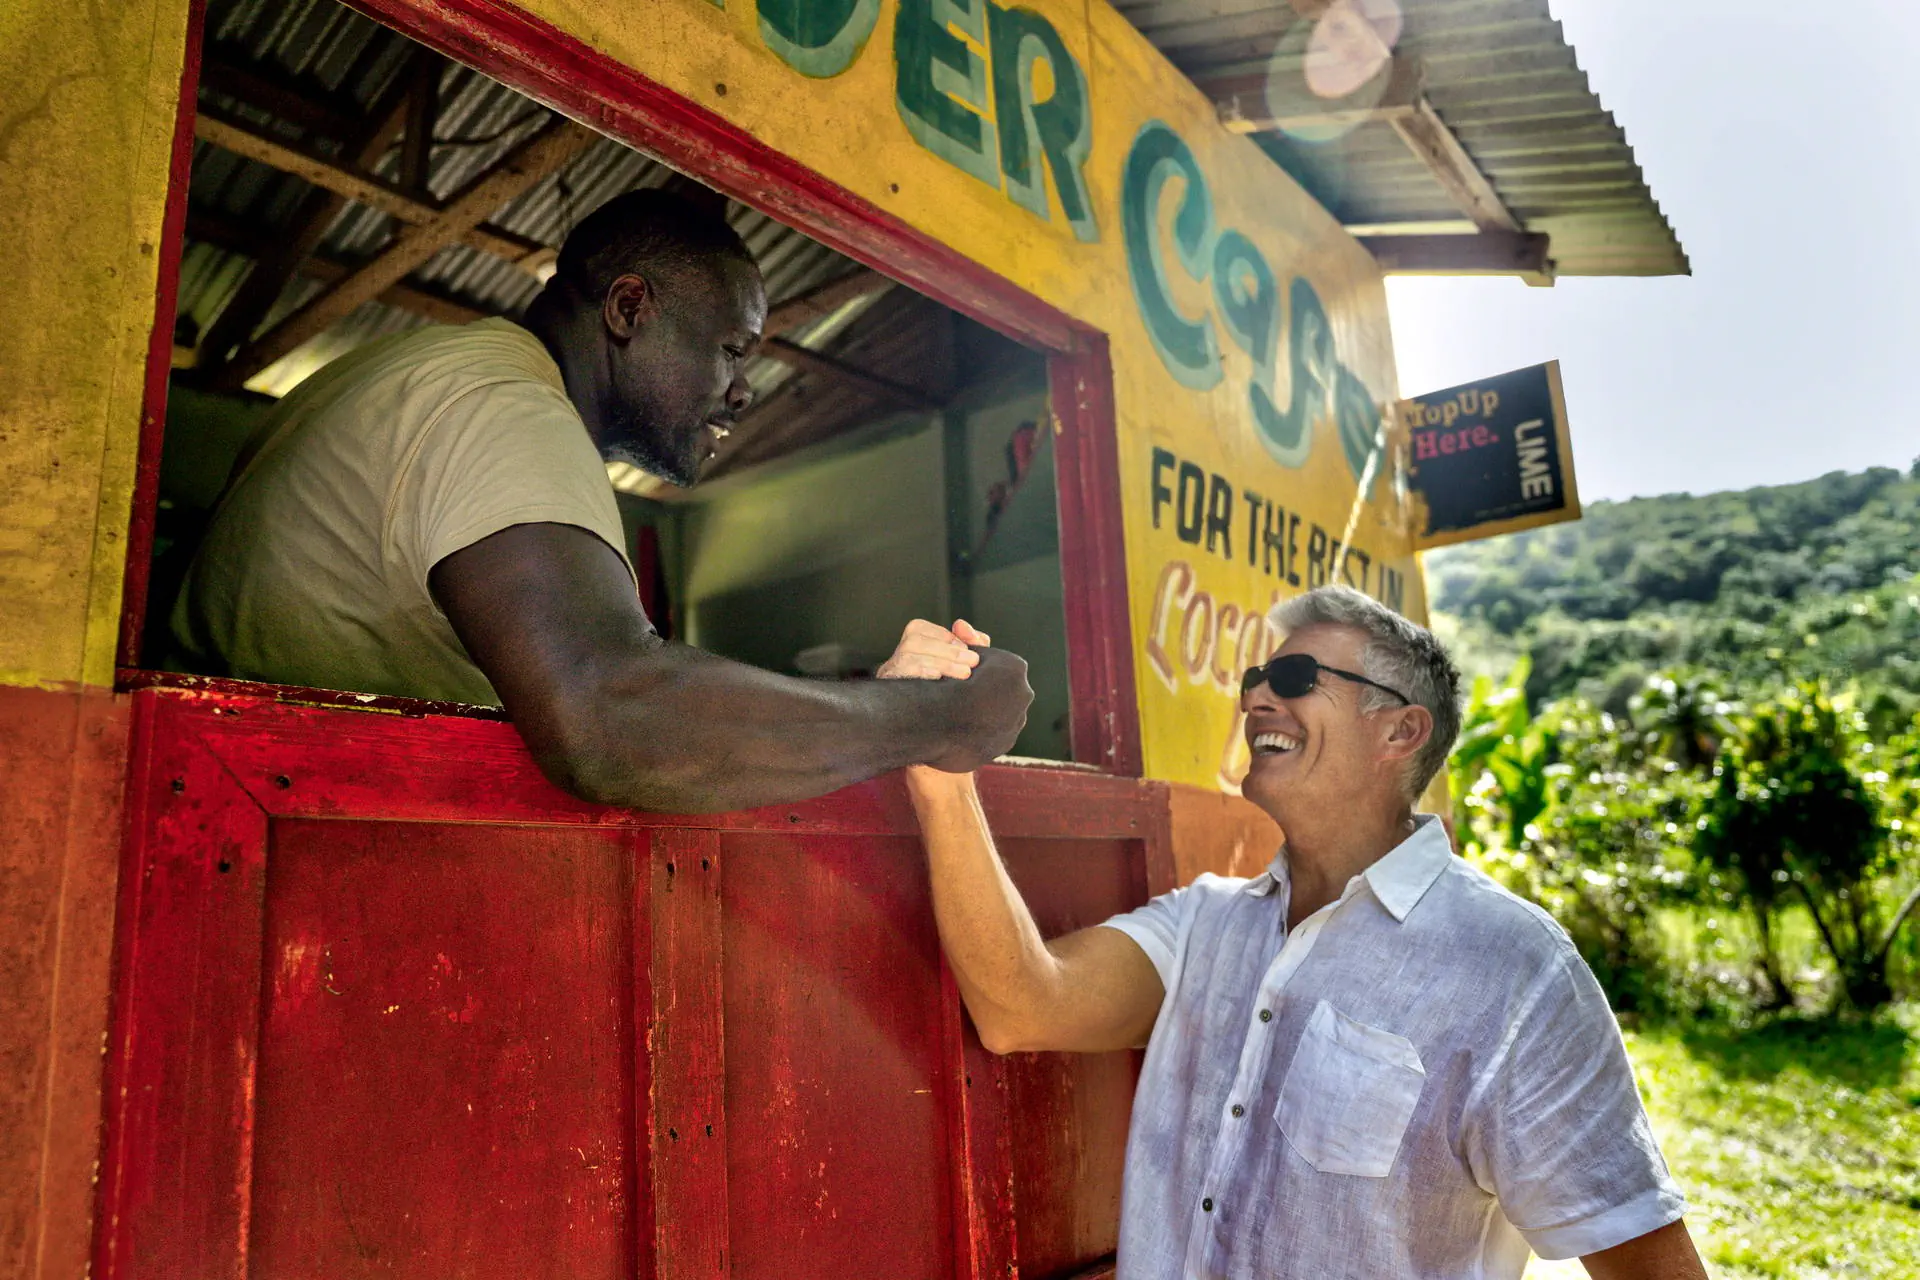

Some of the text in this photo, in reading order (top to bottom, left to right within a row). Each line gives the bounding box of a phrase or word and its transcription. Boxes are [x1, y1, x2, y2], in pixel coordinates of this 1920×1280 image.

[702, 0, 1099, 243] ER
[1415, 425, 1499, 460] Here.
[1152, 446, 1233, 560] FOR
[1243, 491, 1301, 587] THE
